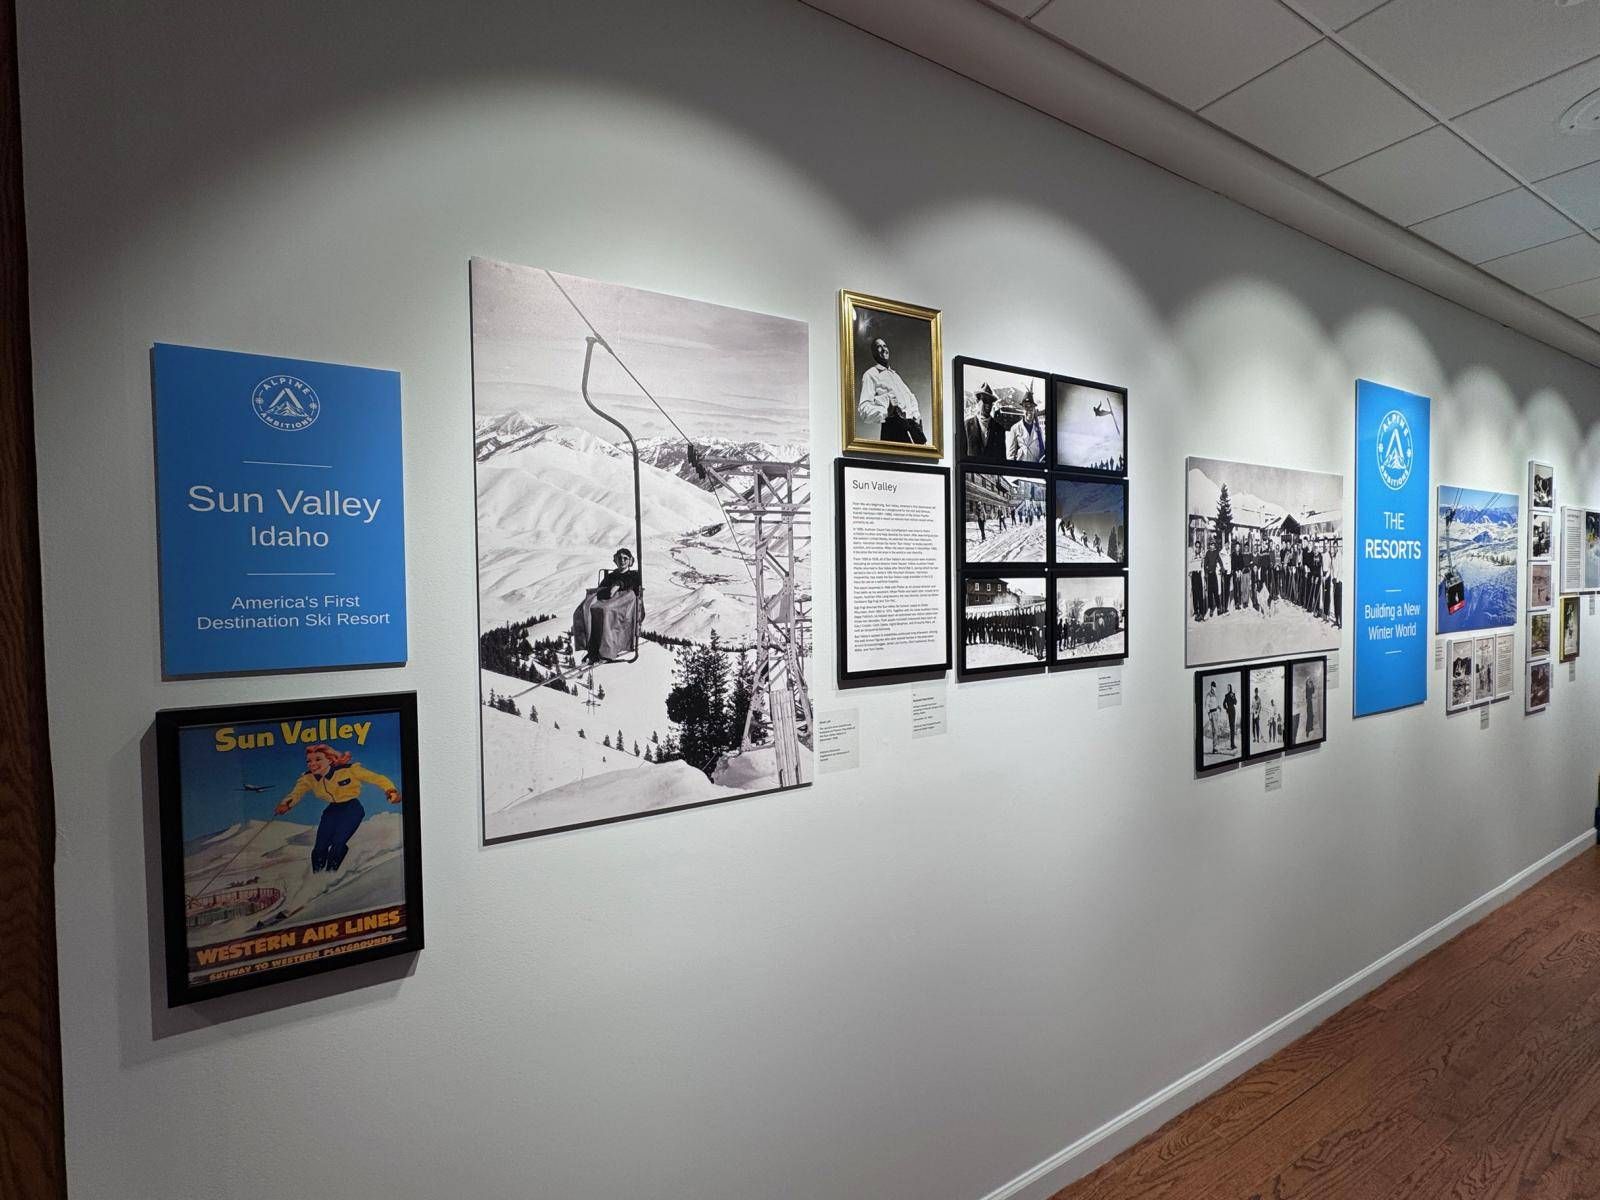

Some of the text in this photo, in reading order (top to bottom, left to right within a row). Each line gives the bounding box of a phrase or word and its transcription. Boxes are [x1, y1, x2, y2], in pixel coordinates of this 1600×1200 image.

[263, 378, 310, 395] ALPINE
[260, 412, 312, 429] AMBITIONS
[852, 479, 898, 493] Sun Valley
[188, 485, 382, 523] Sun Valley
[1383, 511, 1406, 530] THE
[251, 526, 329, 547] Idaho
[1364, 538, 1422, 559] RESORTS
[231, 594, 360, 610] America's First
[1364, 602, 1420, 621] Building a New
[197, 612, 391, 630] Destination Ski Resort
[1368, 622, 1417, 641] Winter World
[215, 717, 372, 752] Sun Valley
[196, 909, 400, 966] WESTERN AIR LINES
[254, 961, 270, 972] TO
[271, 951, 320, 968] WESTERN
[323, 935, 393, 957] PLAYGROUNDS
